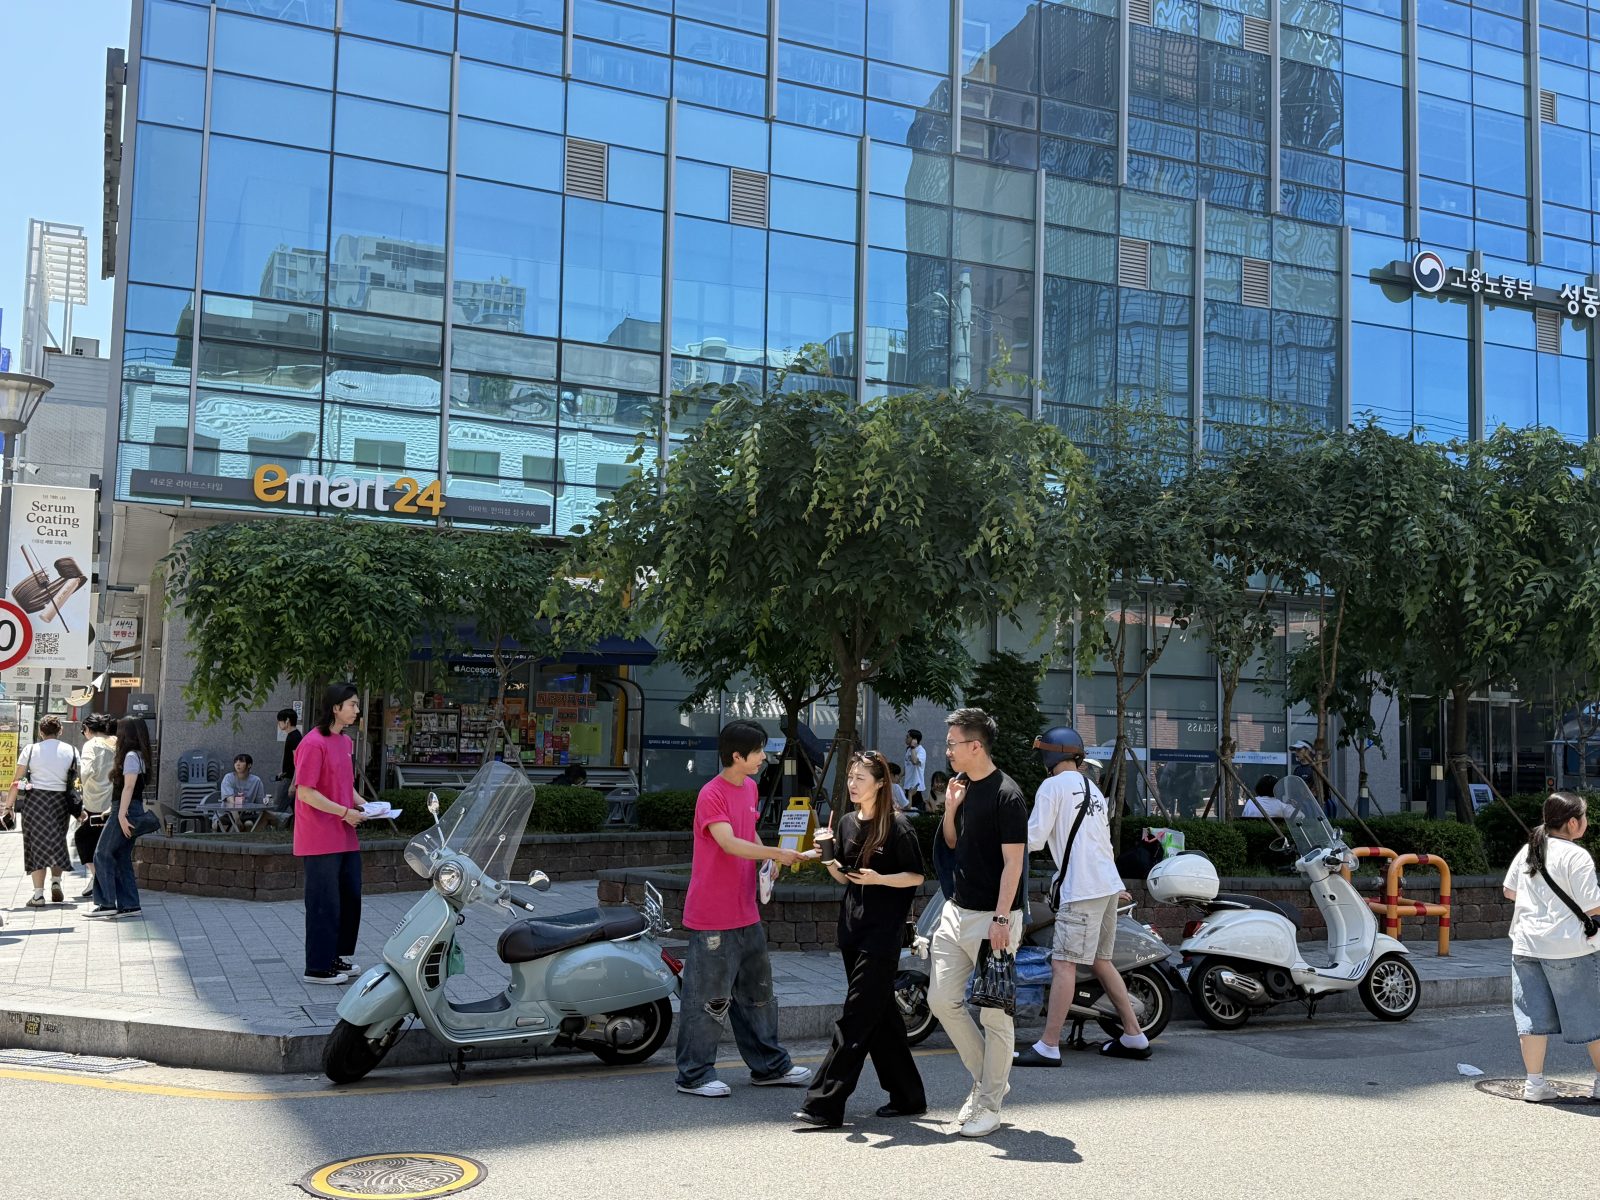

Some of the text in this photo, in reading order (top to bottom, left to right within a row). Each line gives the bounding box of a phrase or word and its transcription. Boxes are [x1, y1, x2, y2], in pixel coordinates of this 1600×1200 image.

[1449, 266, 1600, 318] 고용노동부 성동
[150, 478, 223, 491] 새로운 라이프스타일
[31, 500, 75, 514] Serum
[468, 504, 488, 513] 이마트
[26, 512, 80, 528] Coating
[36, 525, 68, 538] Cara
[112, 630, 136, 638] 부동산
[460, 664, 500, 674] Accessori
[0, 739, 15, 753] 싹
